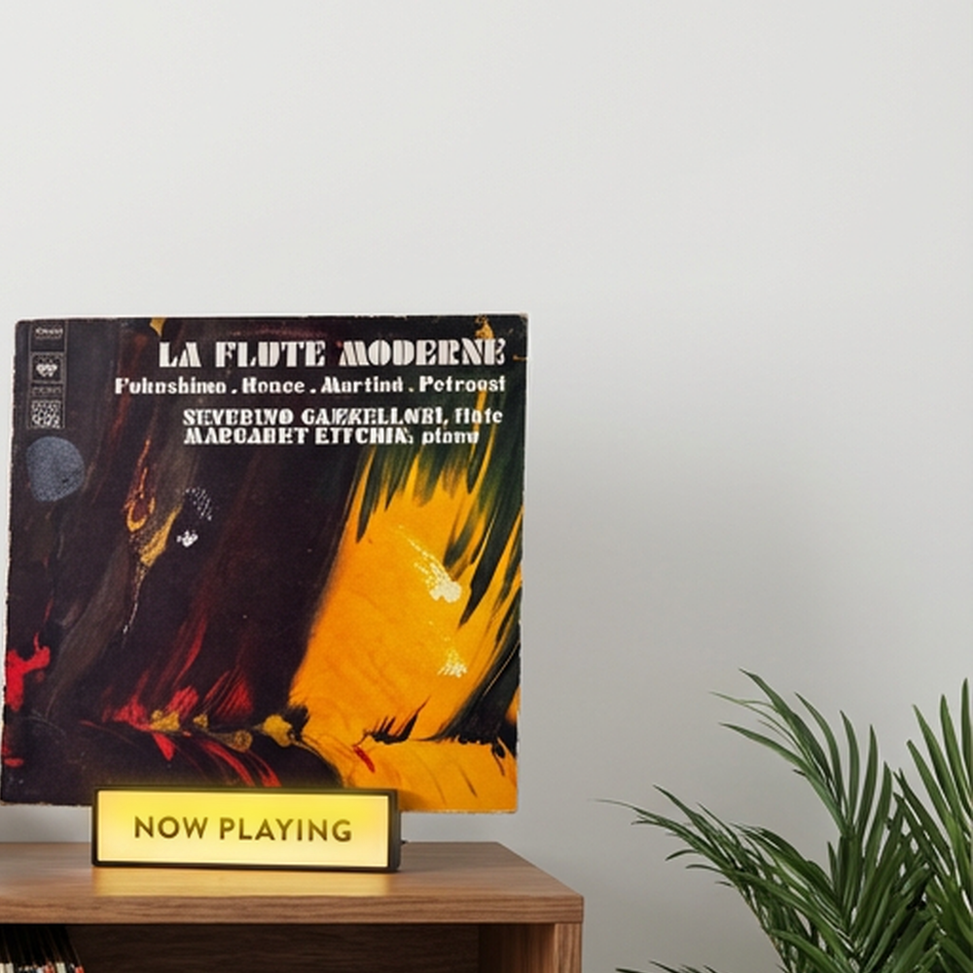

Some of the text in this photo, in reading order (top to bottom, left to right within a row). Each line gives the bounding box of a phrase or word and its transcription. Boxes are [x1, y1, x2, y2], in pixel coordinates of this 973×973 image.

[159, 341, 202, 368] LA
[339, 338, 507, 367] MODERNE
[134, 816, 353, 842] NOW PLAYING
